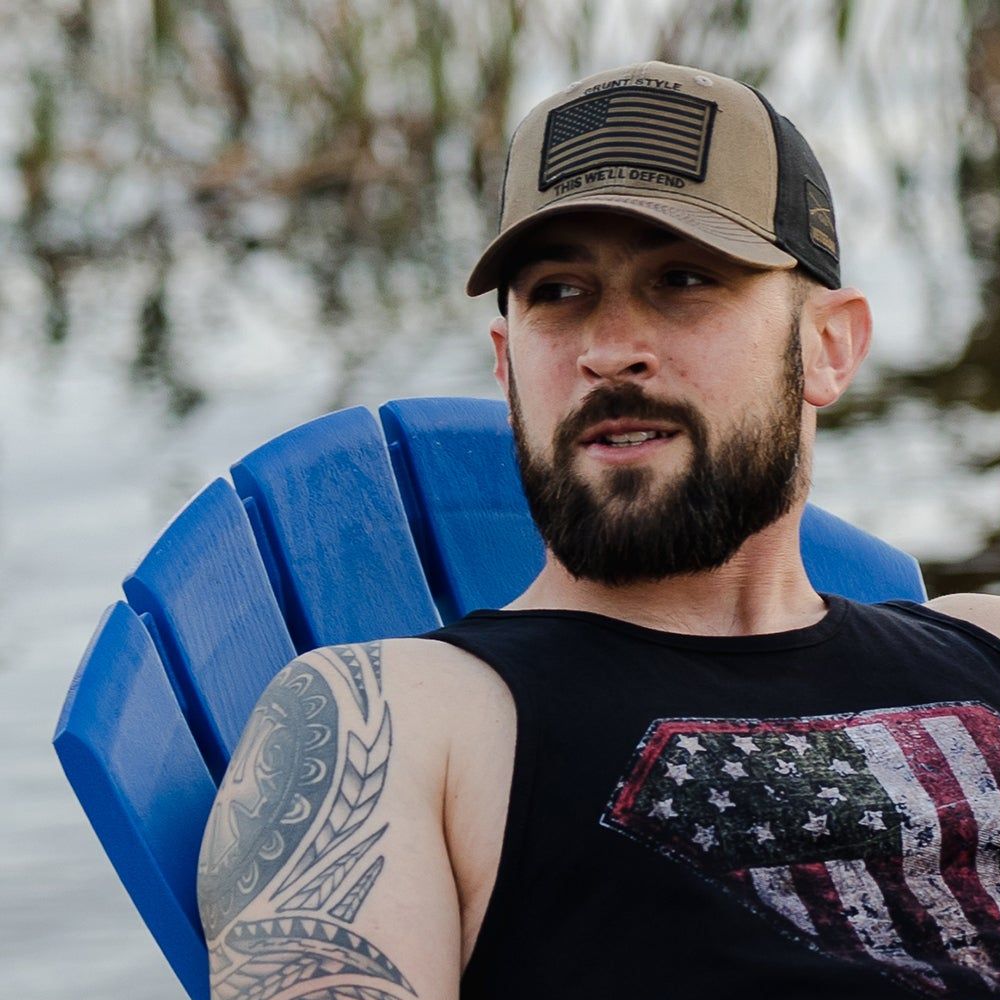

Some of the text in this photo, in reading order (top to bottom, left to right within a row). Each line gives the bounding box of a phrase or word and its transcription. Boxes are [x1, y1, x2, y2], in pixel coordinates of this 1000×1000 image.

[635, 78, 682, 91] STYLE
[554, 177, 582, 195] THIS
[629, 170, 685, 188] DEFEND
